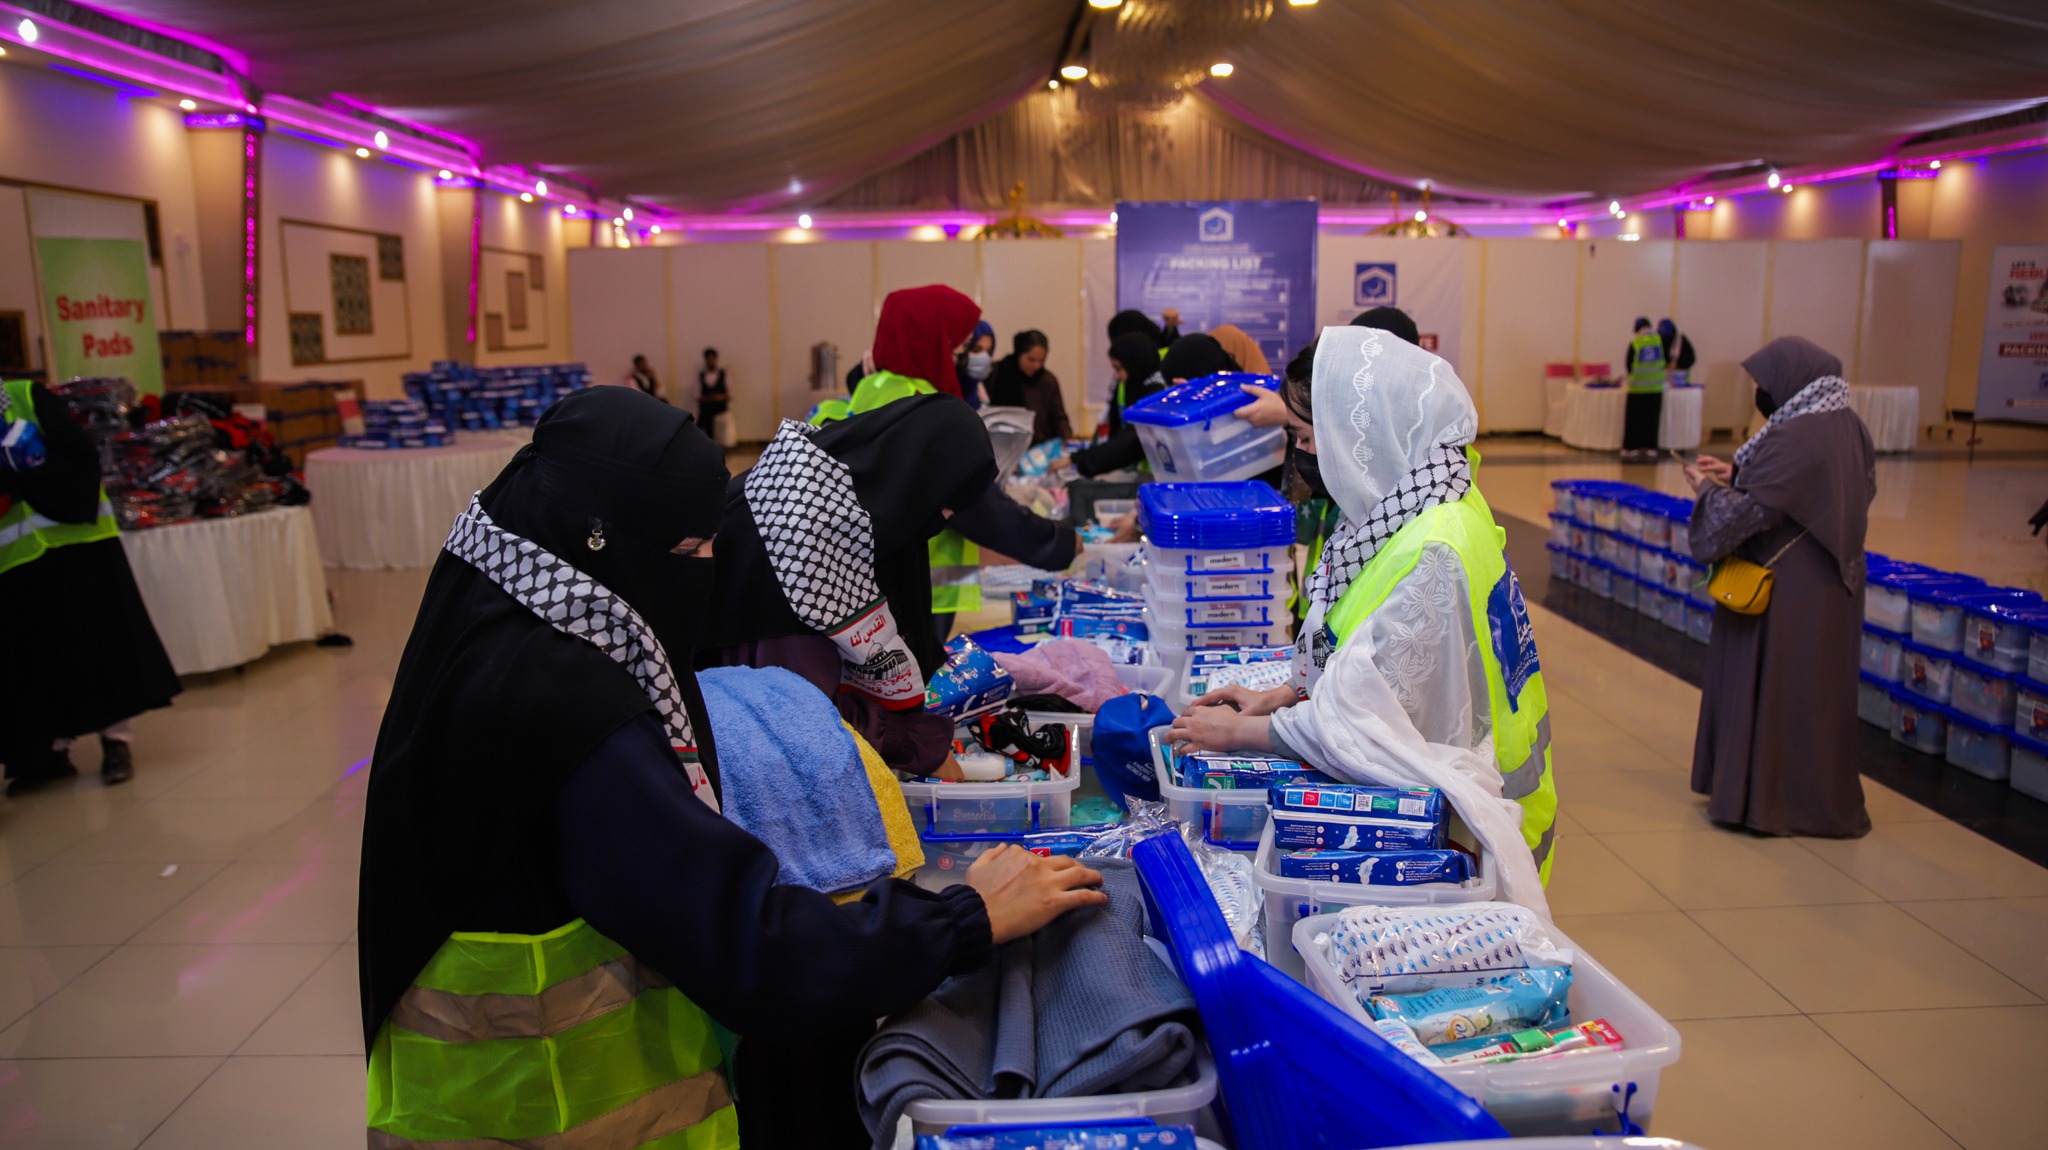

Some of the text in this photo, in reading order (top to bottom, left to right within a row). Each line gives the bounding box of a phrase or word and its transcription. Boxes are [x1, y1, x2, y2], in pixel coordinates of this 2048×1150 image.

[1170, 256, 1262, 271] PACKING LIST
[56, 294, 144, 323] Sanitary
[82, 332, 133, 358] Pads
[1210, 556, 1238, 564] modern
[1207, 610, 1235, 618] modern
[850, 614, 887, 647] القدس لنا
[953, 808, 997, 823] Butterfly
